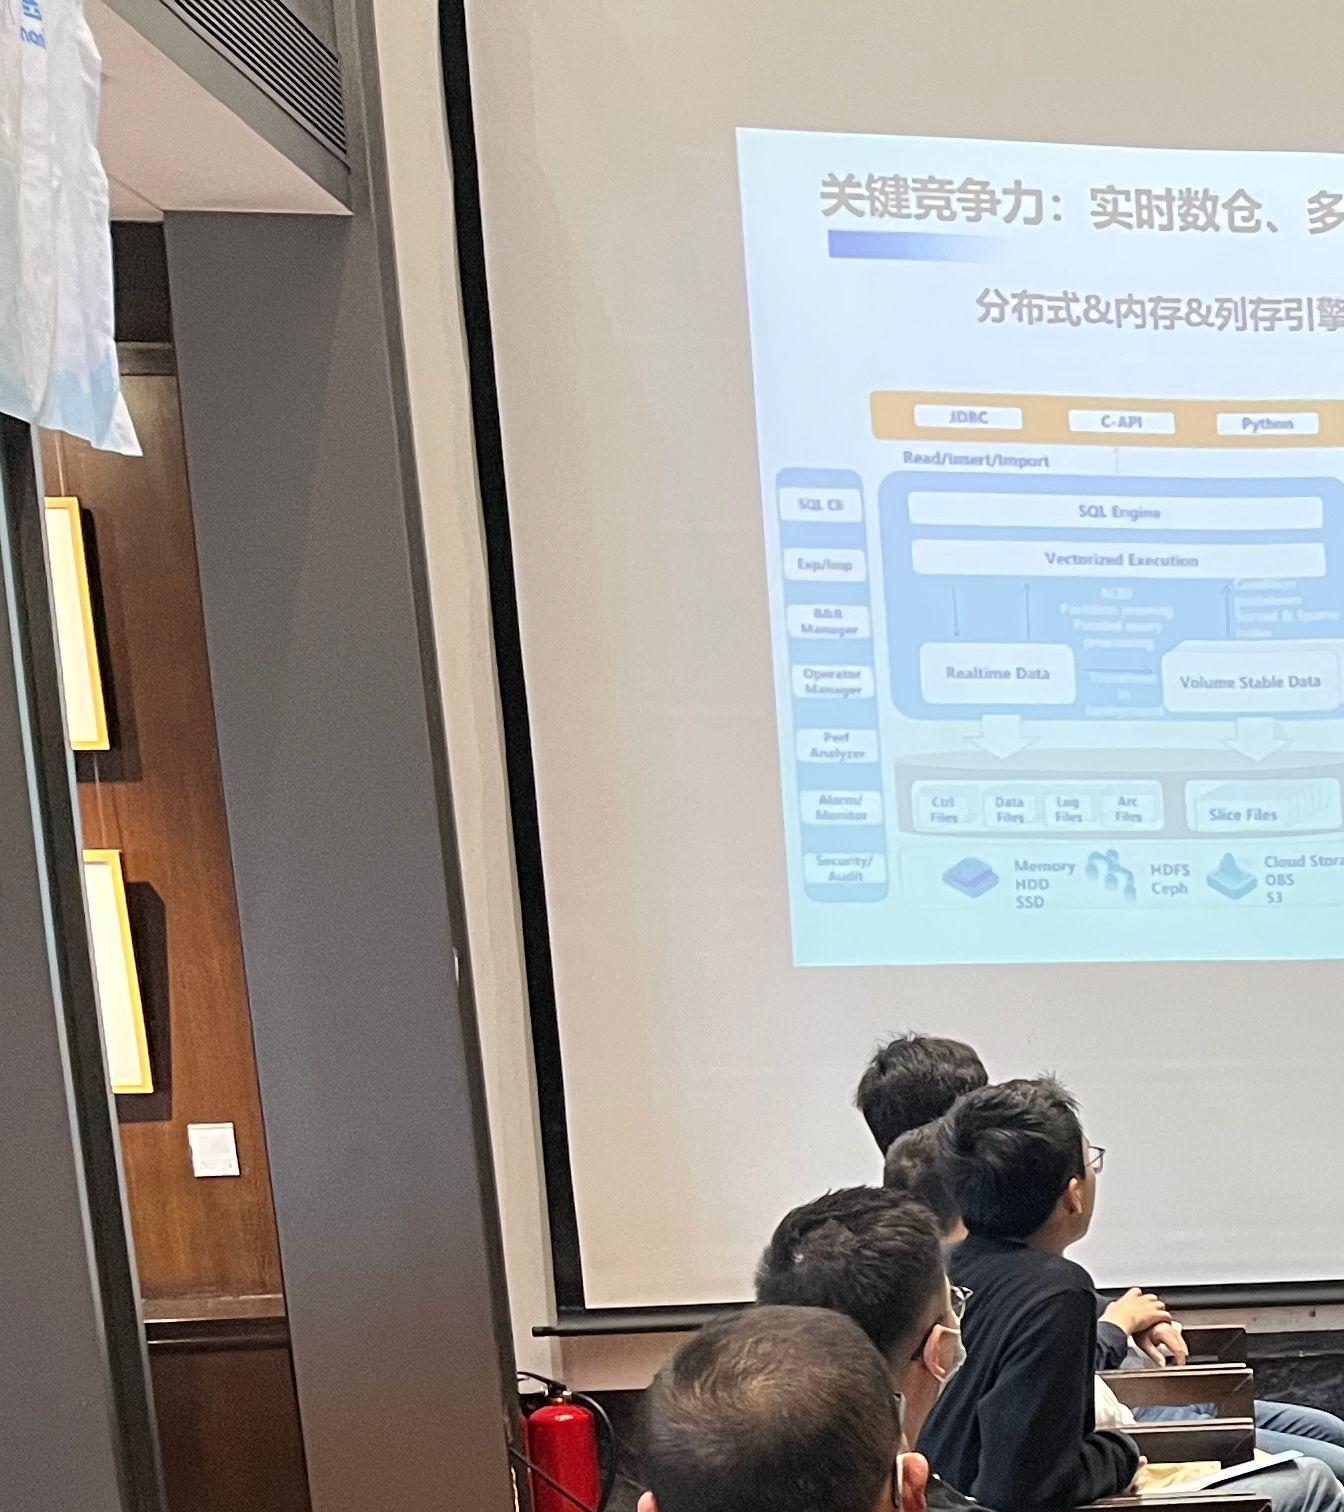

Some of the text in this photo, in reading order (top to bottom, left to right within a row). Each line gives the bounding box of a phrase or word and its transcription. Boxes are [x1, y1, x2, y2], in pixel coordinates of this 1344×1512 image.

[948, 409, 989, 425] JDBC
[1240, 416, 1295, 434] Python
[903, 450, 1051, 469] Read/Insert/Import
[1078, 503, 1161, 522] SQL Engine
[1045, 551, 1199, 567] Vectorized Execution
[803, 668, 861, 682] Operator
[946, 665, 1051, 680] Realtime Data
[1180, 674, 1321, 689] Volume Stable Data
[995, 796, 1025, 808] Data
[930, 811, 958, 823] Files
[996, 811, 1025, 823] Files
[1055, 811, 1083, 823] Files
[1115, 810, 1143, 822] Files
[1208, 807, 1278, 821] Slice Files
[1014, 858, 1076, 873] Memory
[1263, 854, 1306, 868] Cloud
[1150, 862, 1190, 876] HDFS
[1015, 877, 1049, 890] HDD
[1264, 872, 1295, 886] OBS
[1151, 880, 1189, 895] Ceph
[1015, 894, 1045, 908] SSD
[1266, 890, 1283, 903] S3
